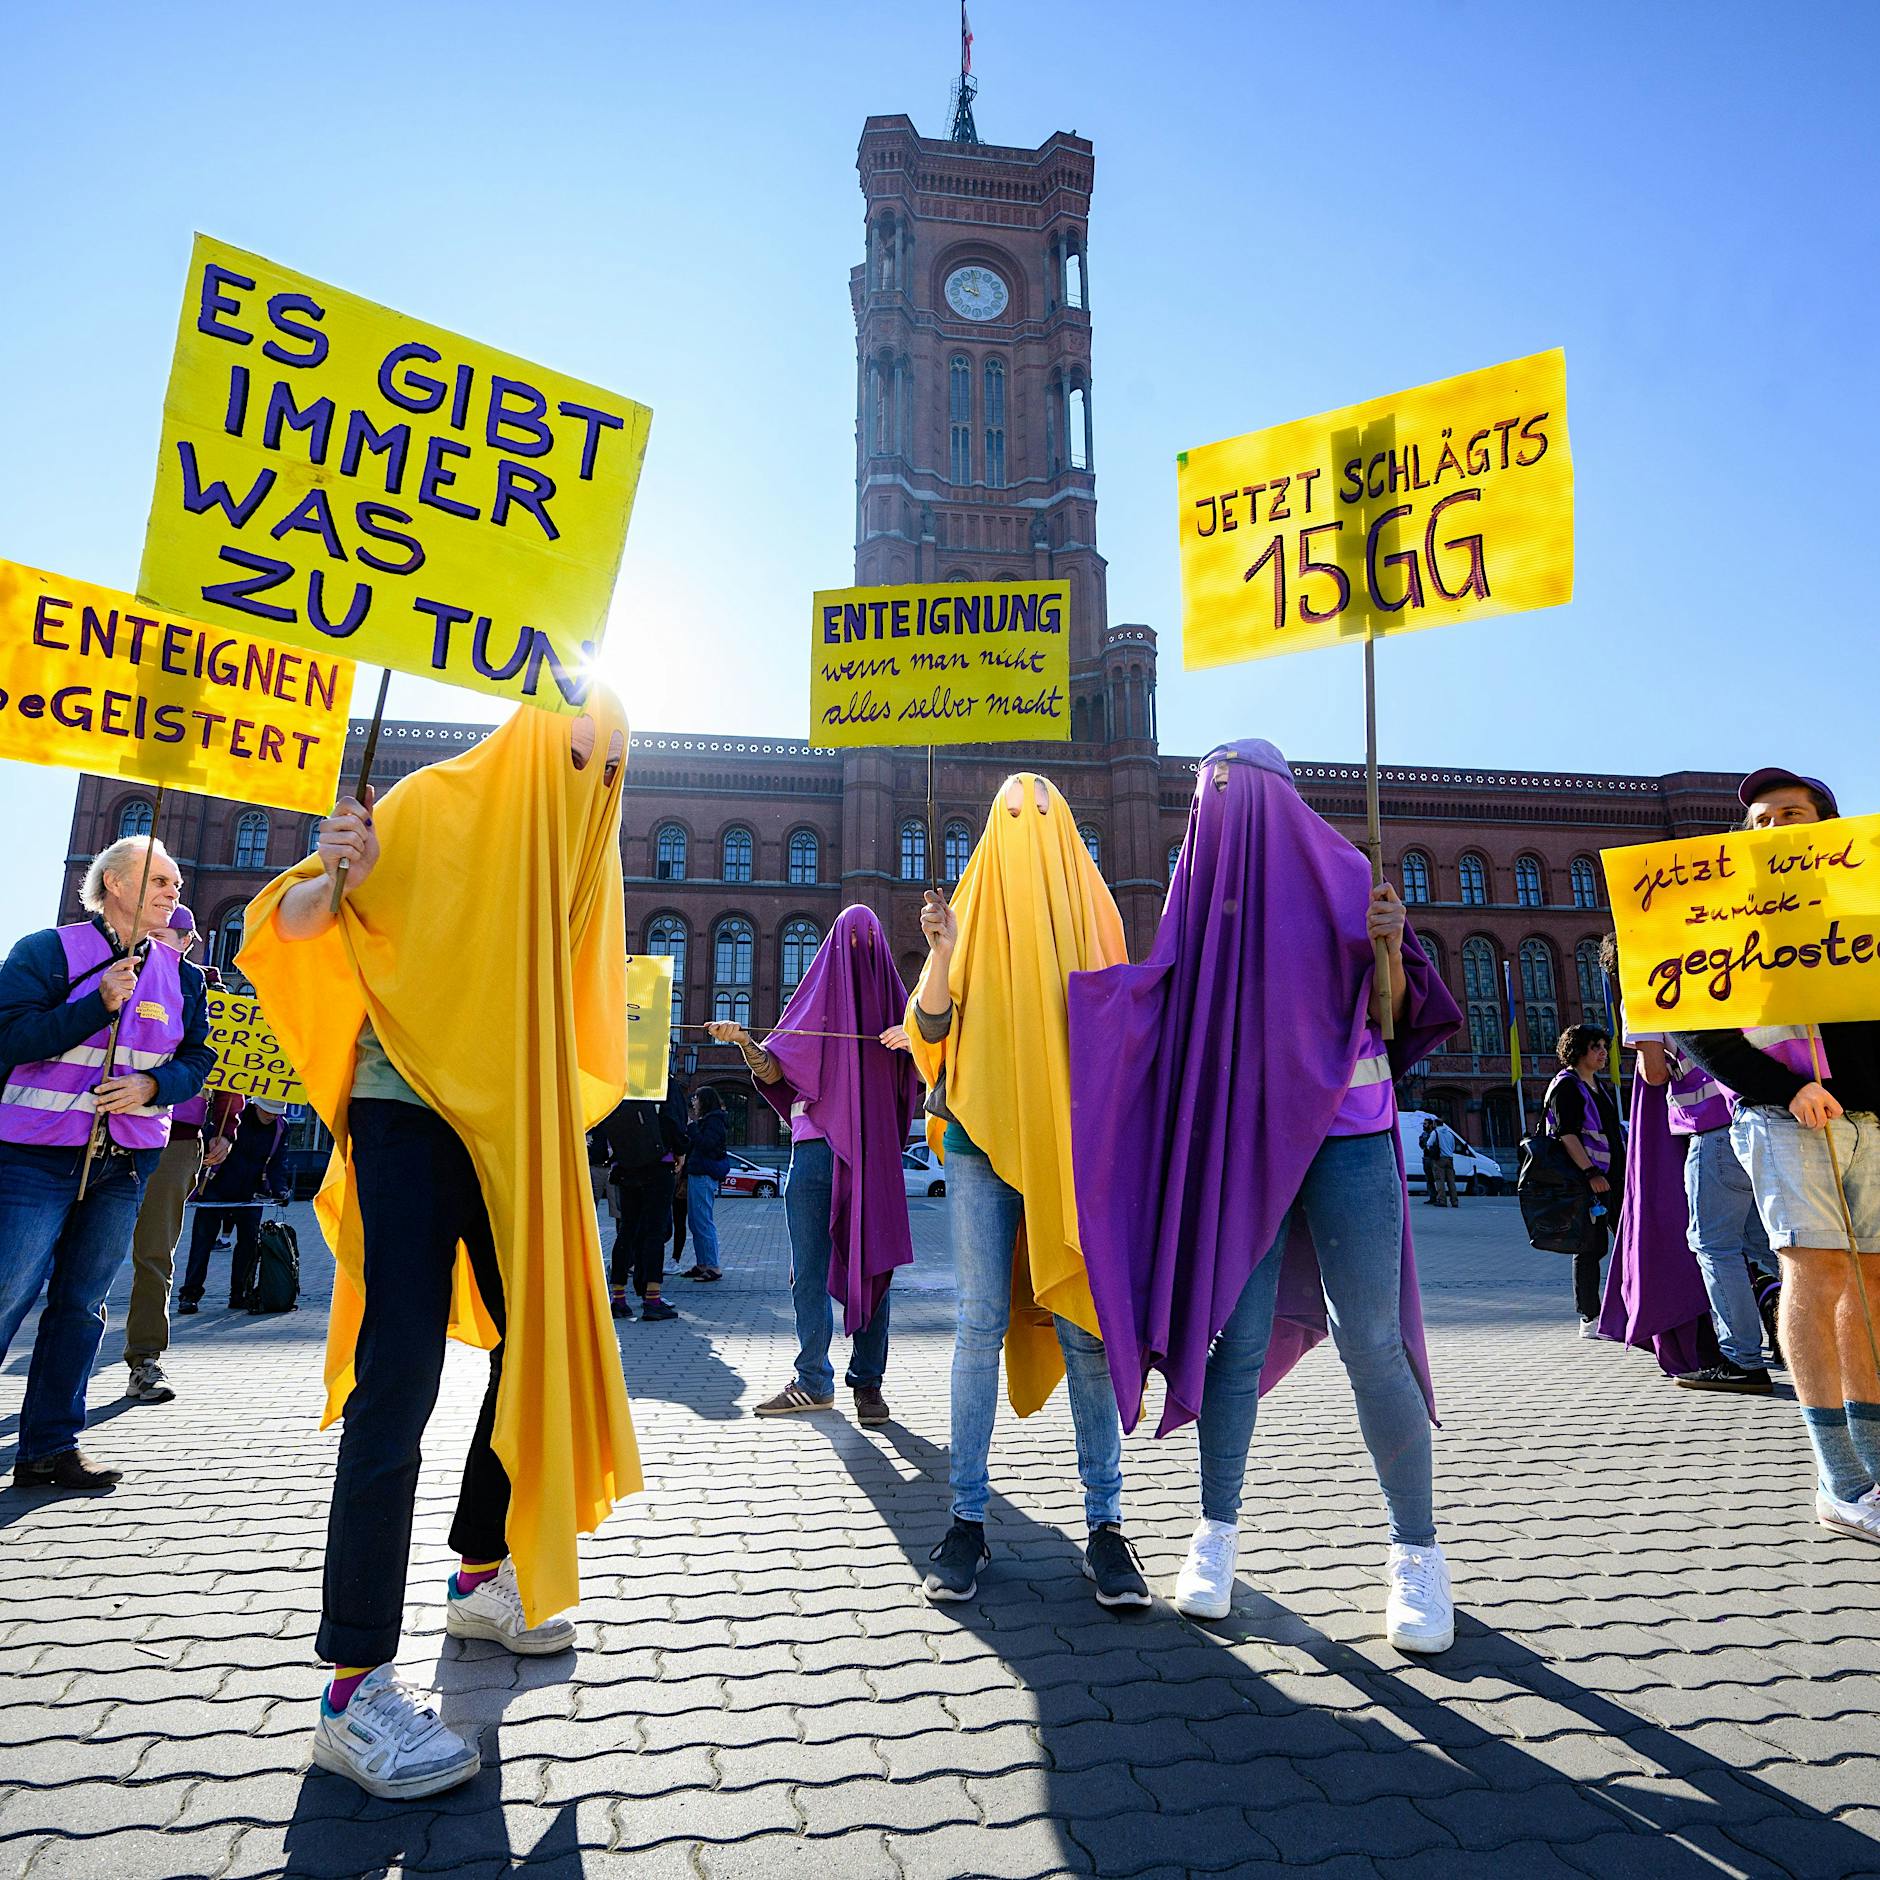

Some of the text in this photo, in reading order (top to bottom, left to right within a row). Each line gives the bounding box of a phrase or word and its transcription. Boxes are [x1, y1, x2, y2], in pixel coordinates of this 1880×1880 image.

[198, 264, 624, 480] ES GIBT
[225, 365, 561, 541] IMMER
[1196, 411, 1550, 537] JETZT SCHLÄGTS
[176, 441, 426, 576] WAS
[33, 595, 339, 712] ENTEIGNEN
[201, 545, 595, 707] ZU TUN
[821, 648, 1046, 682] wenn man nicht
[823, 593, 1062, 644] ENTEIGNUNG
[822, 685, 1063, 725] alles selber macht
[1634, 838, 1865, 912] jetzt wird
[1648, 920, 1880, 1010] geghoste
[290, 1104, 302, 1118] U
